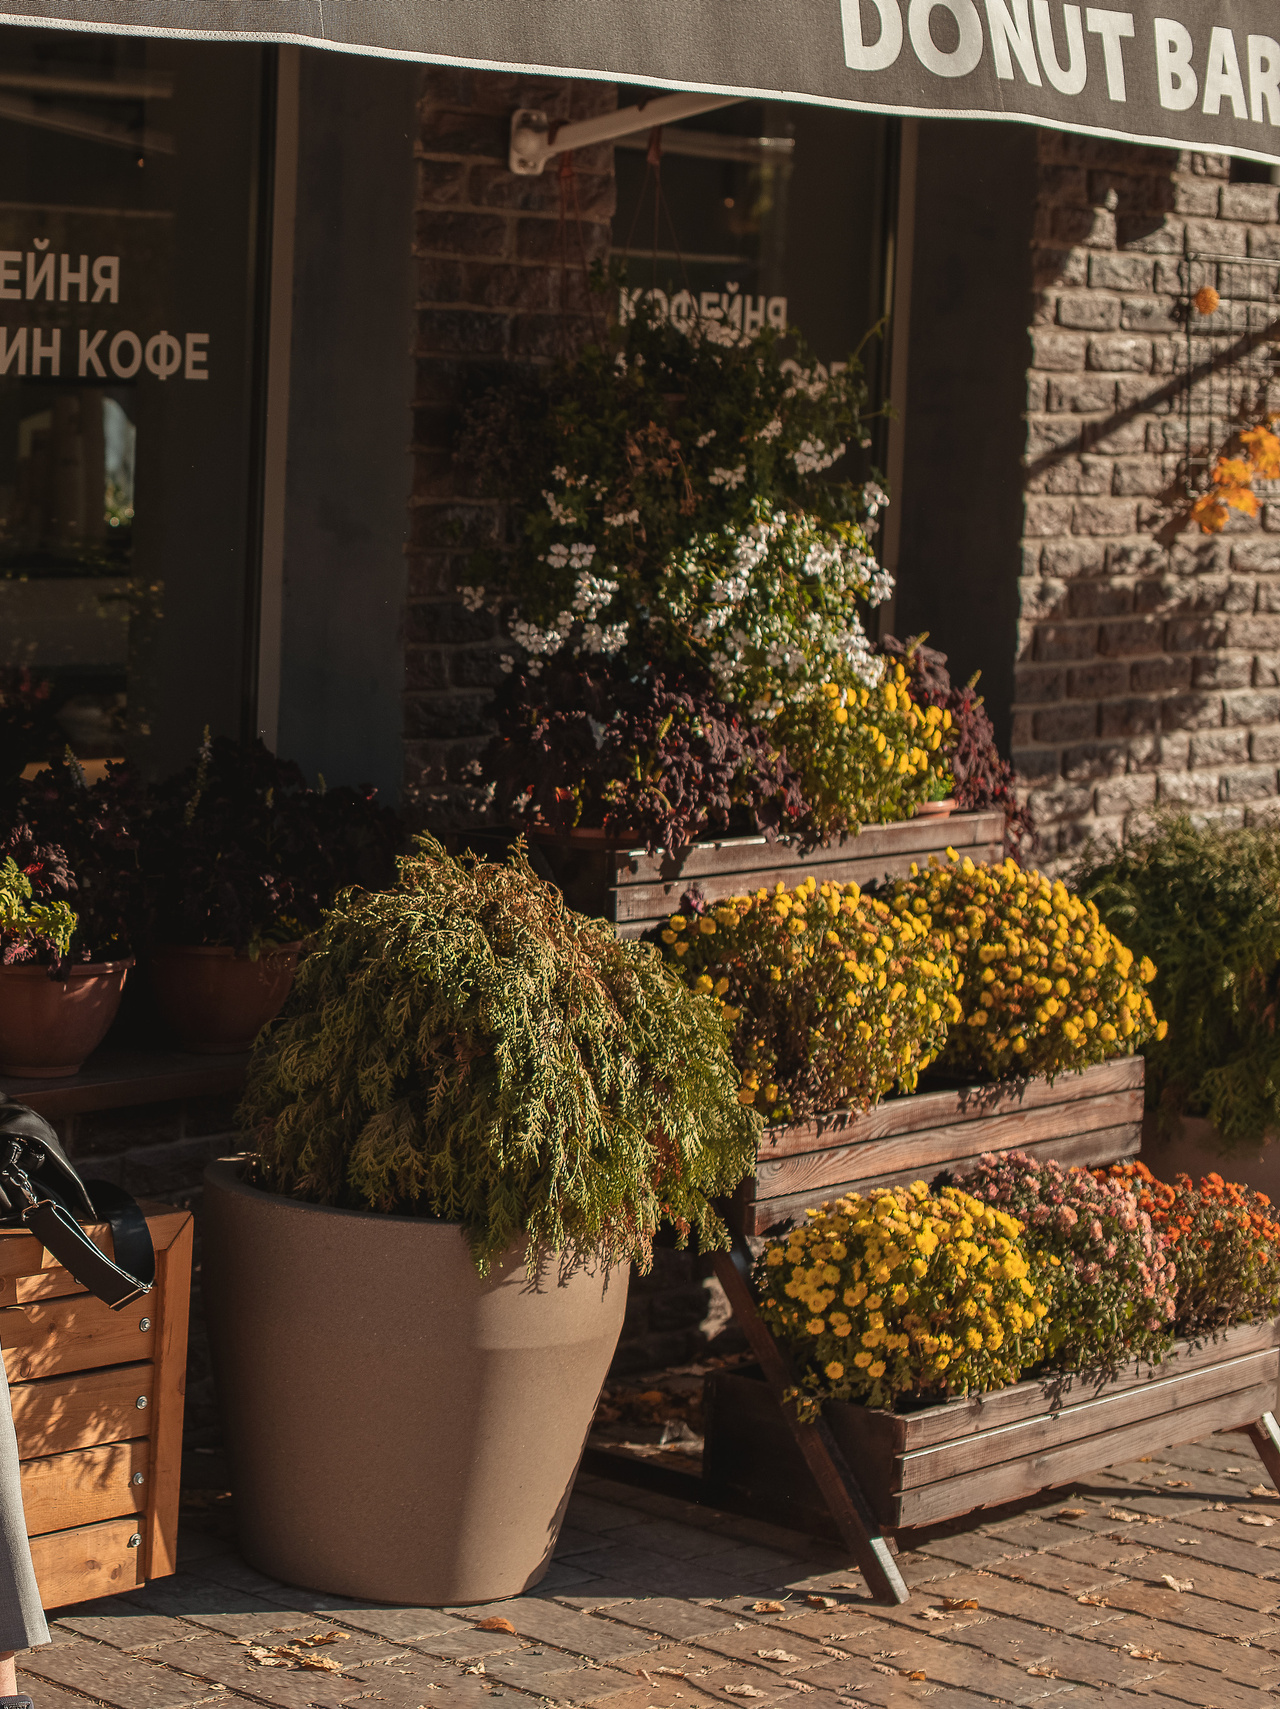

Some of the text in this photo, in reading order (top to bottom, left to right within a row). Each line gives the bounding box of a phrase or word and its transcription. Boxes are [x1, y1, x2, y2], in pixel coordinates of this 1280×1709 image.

[840, 0, 1280, 126] DONUT BAR
[78, 329, 210, 381] КОФЕ
